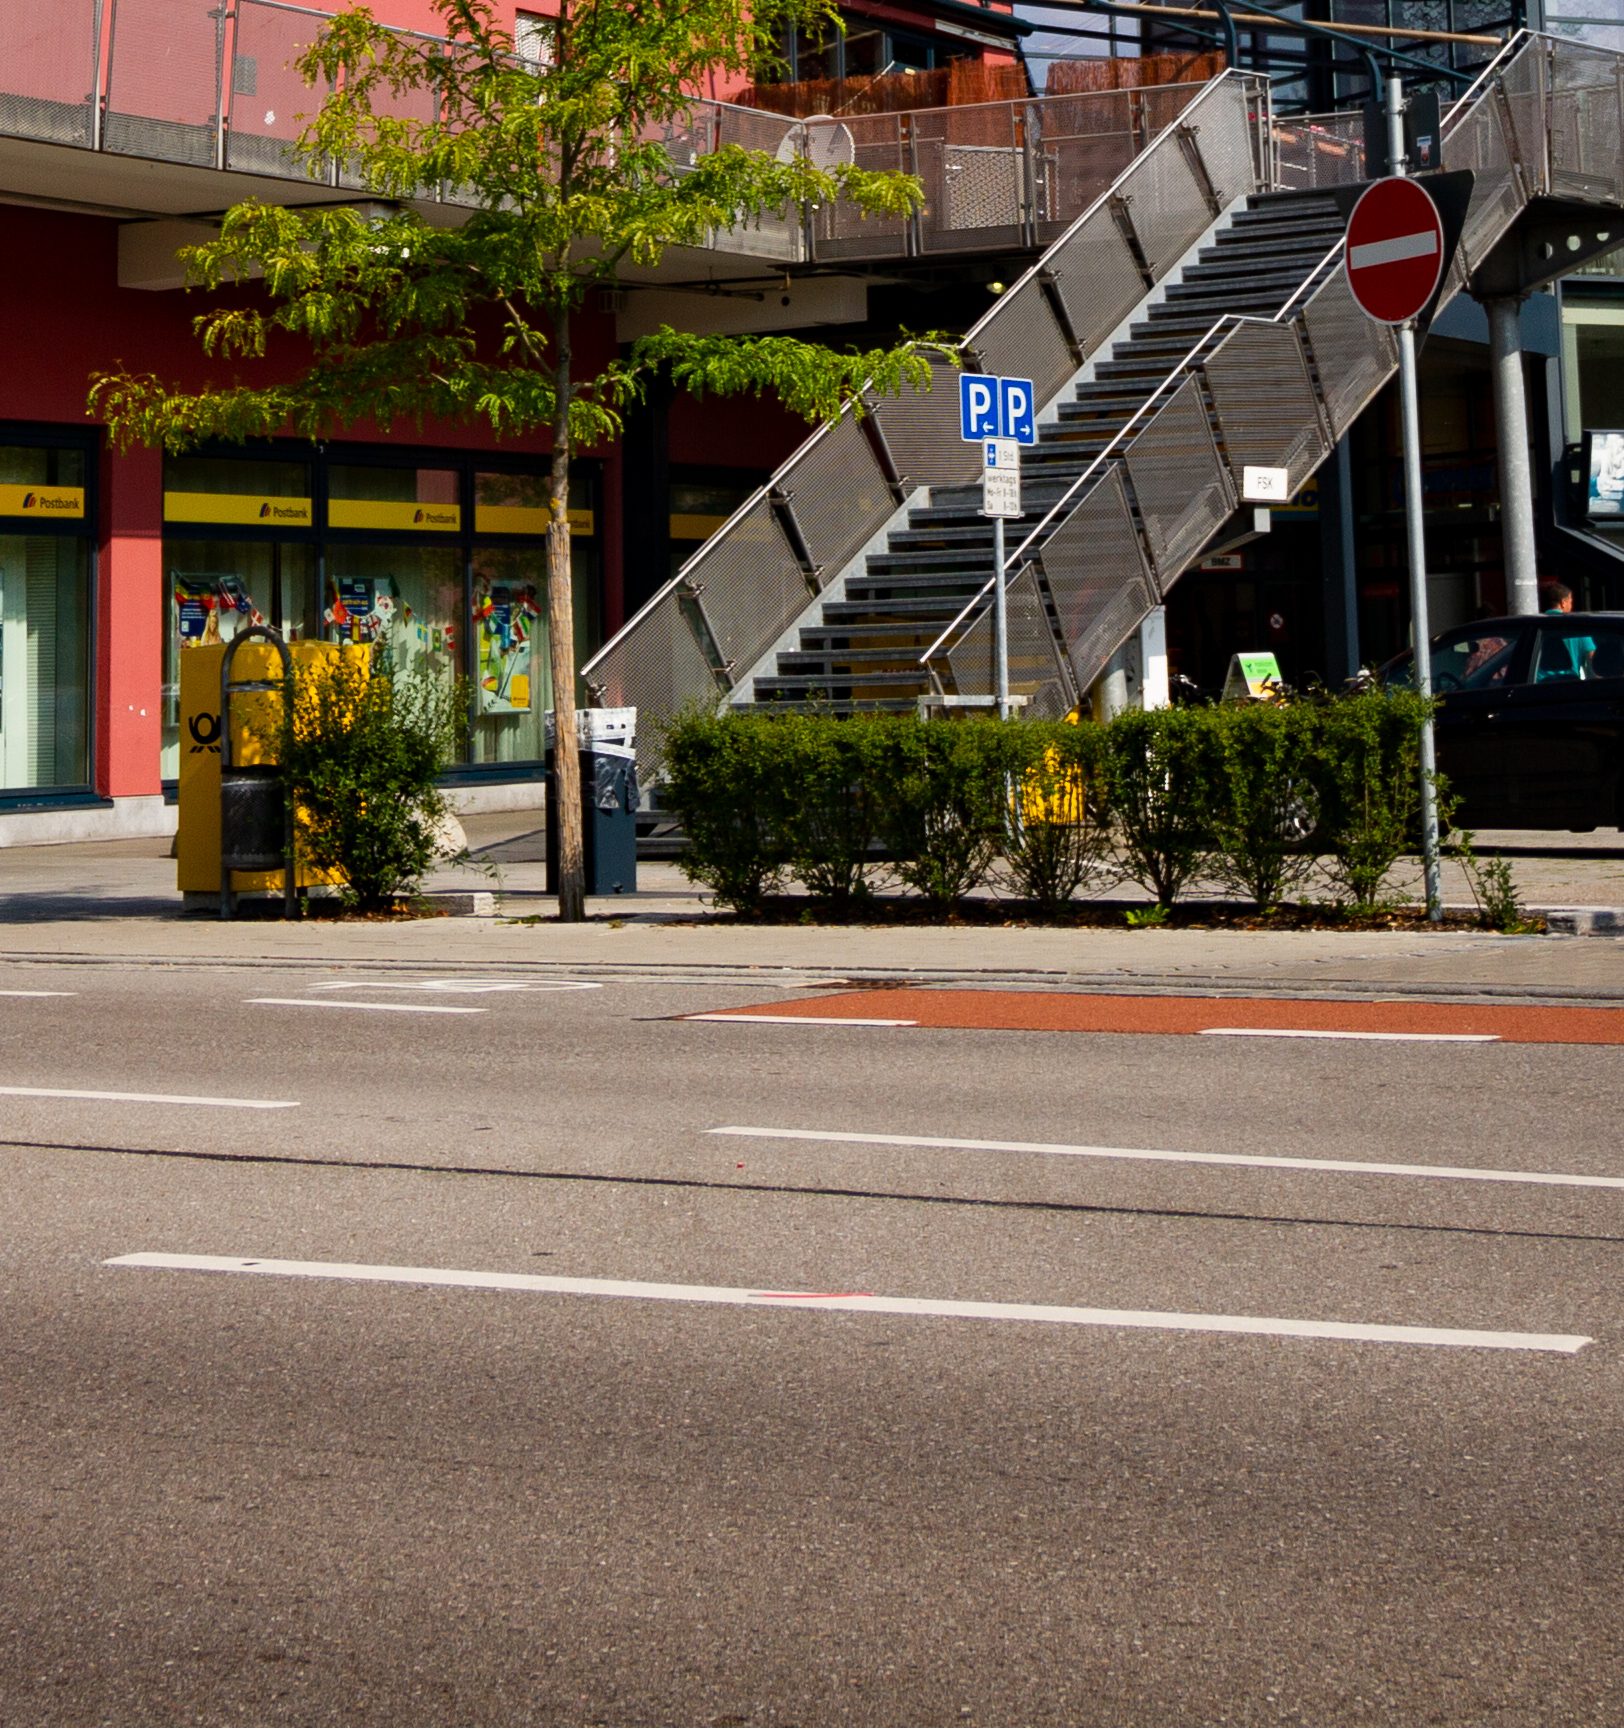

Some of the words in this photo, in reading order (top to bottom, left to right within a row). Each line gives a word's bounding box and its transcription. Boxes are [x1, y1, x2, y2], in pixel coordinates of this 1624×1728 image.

[969, 383, 991, 433] P
[1007, 387, 1027, 435] P
[987, 474, 1017, 487] werktags
[1257, 476, 1274, 490] FSK
[40, 497, 80, 510] Postbank
[273, 506, 308, 520] Postbank
[426, 512, 457, 524] Postbank
